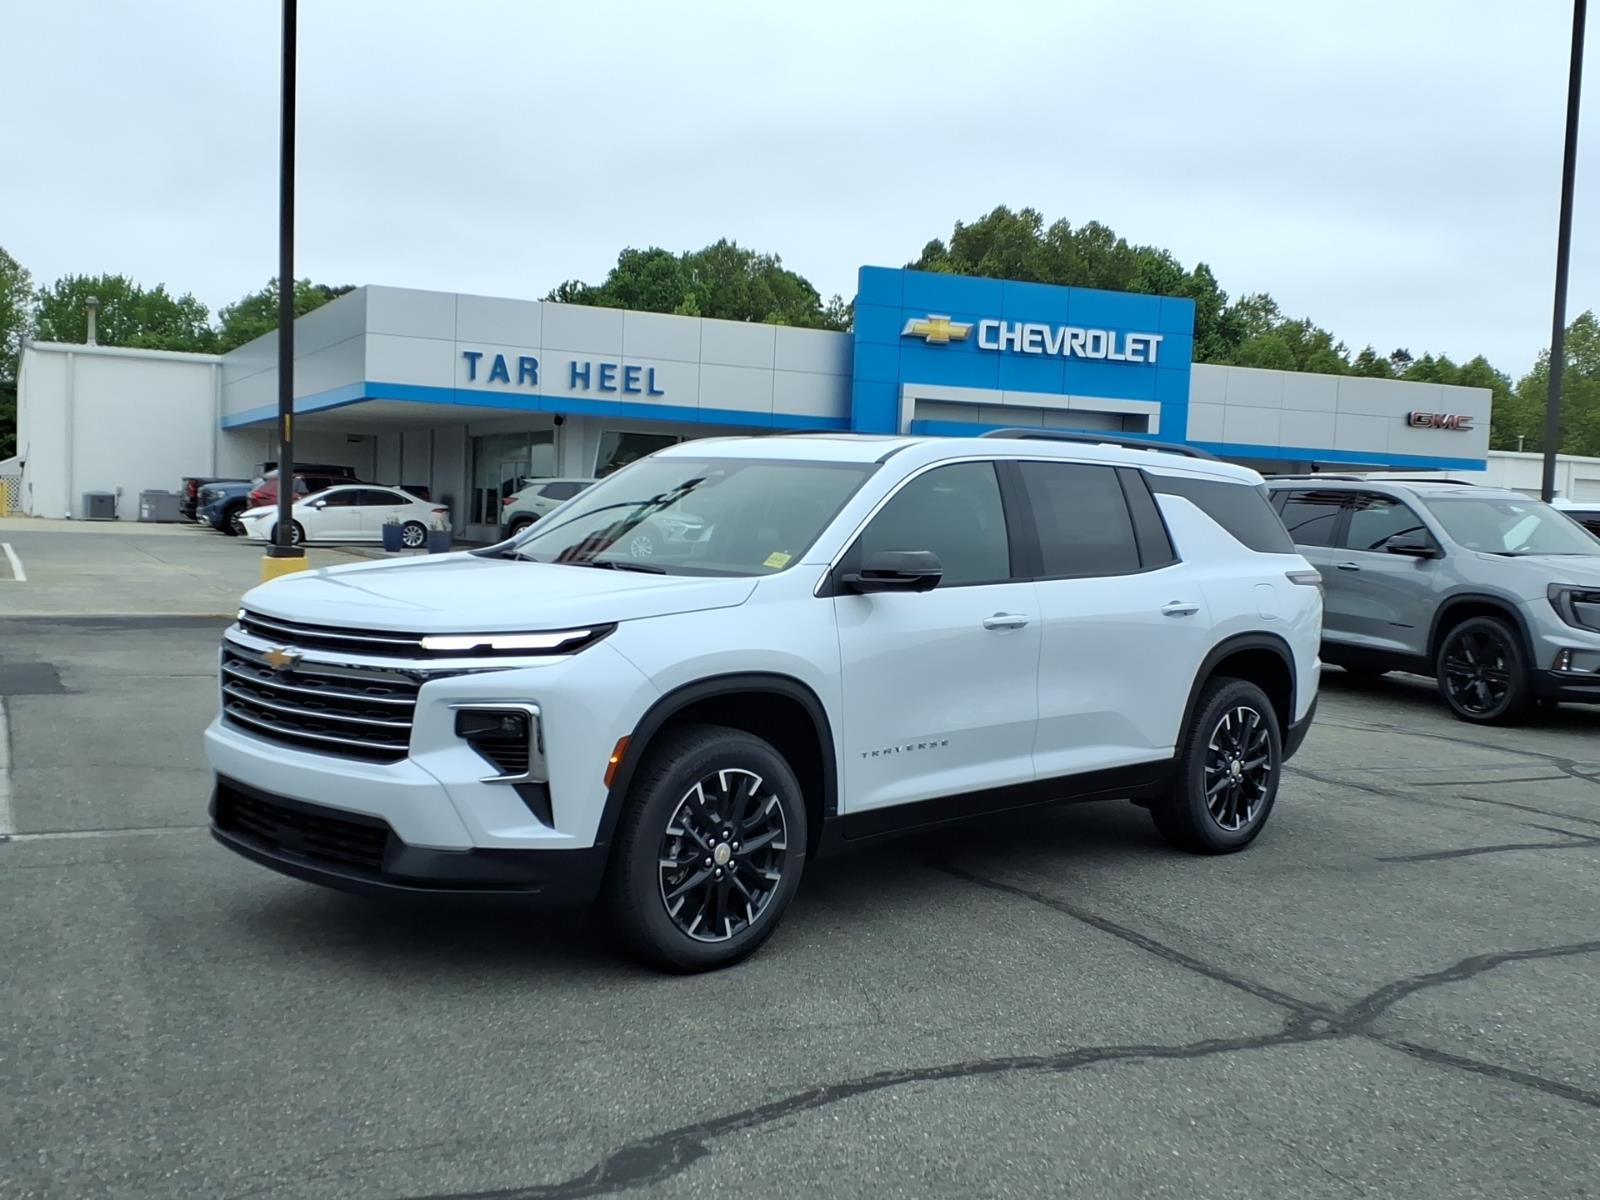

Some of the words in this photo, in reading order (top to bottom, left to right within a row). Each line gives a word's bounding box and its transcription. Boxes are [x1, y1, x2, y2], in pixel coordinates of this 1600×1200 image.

[978, 319, 1163, 363] CHEVROLET
[463, 351, 539, 385] TAR
[569, 361, 664, 396] HEEL
[1407, 411, 1474, 431] GMC
[861, 740, 949, 759] TRAVERSE
